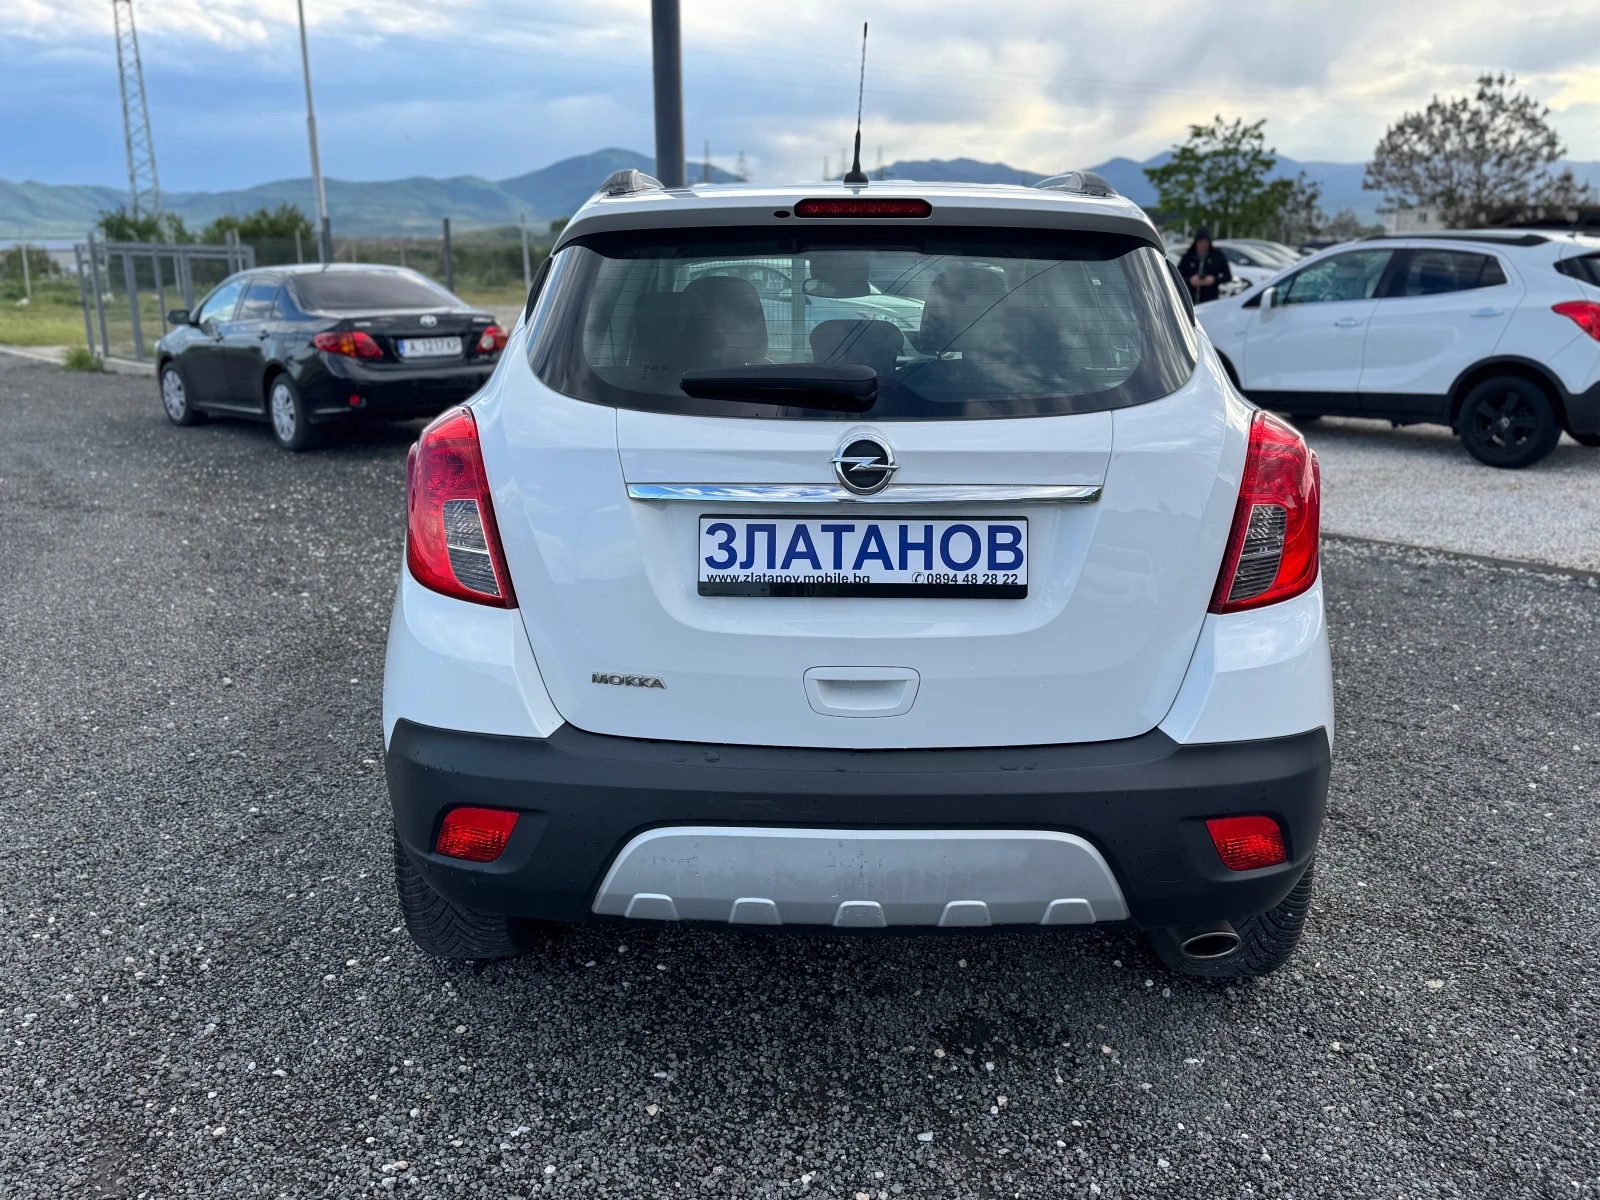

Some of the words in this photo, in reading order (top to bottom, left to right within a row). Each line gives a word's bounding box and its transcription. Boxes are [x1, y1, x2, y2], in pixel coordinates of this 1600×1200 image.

[704, 522, 1024, 571] ЗЛАТАНОВ
[706, 572, 870, 584] www.zlatanov.mobile.bg
[926, 573, 958, 585] 0894
[962, 573, 978, 585] 48
[982, 573, 998, 585] 28
[1002, 573, 1018, 585] 22
[591, 672, 667, 689] MOKKA
